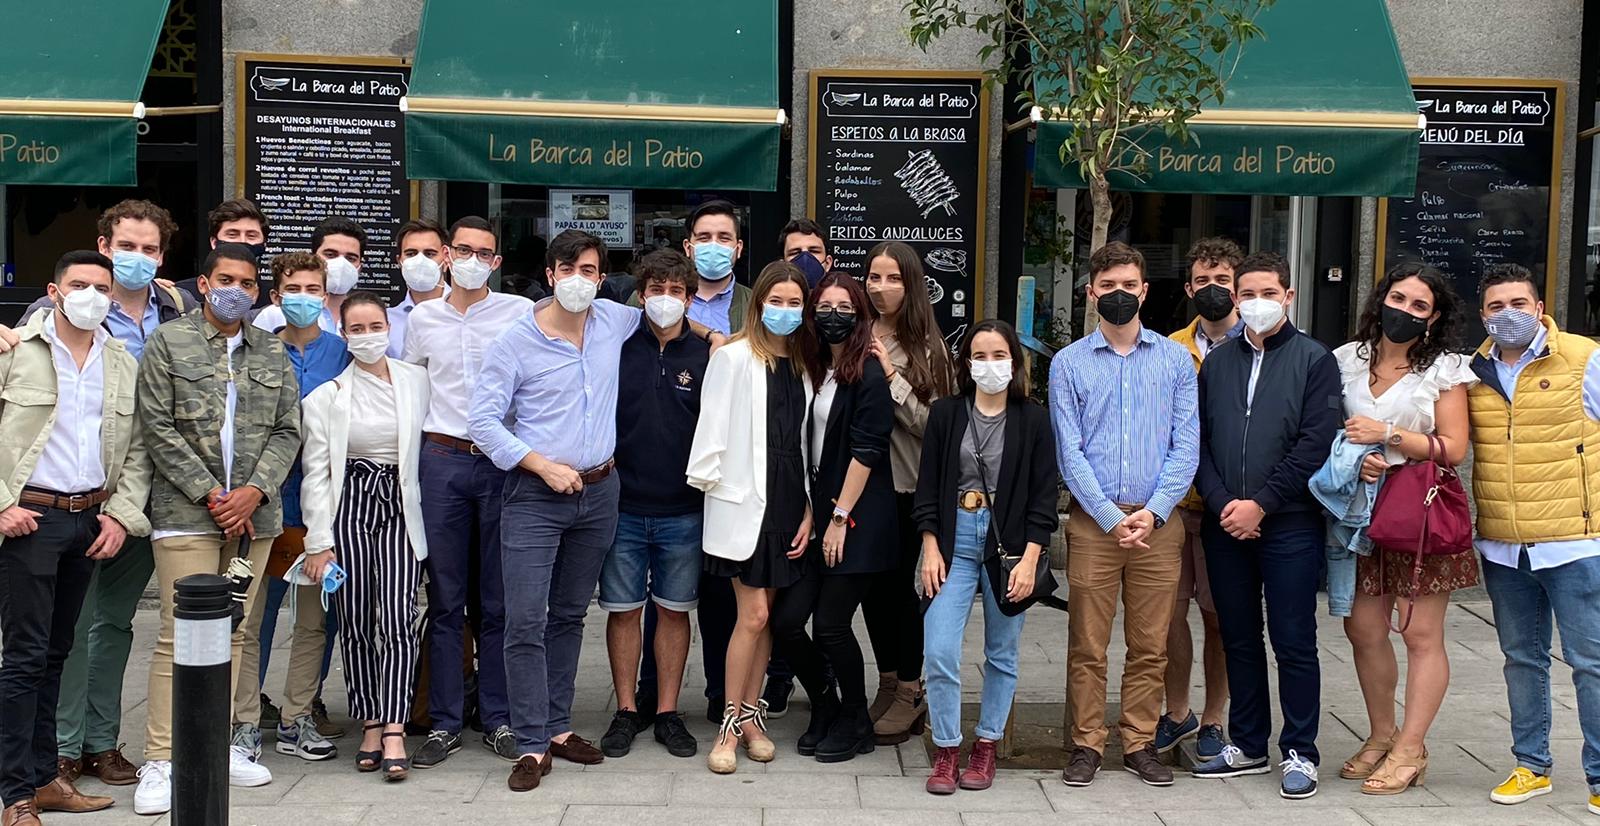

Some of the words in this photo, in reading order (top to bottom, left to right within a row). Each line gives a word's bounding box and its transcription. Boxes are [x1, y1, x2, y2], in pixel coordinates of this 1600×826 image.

[292, 78, 306, 92] La
[313, 80, 344, 94] Barca
[350, 81, 364, 94] del
[370, 80, 400, 96] Patio
[863, 92, 877, 106] La
[884, 94, 914, 107] Barca
[919, 94, 934, 108] del
[940, 93, 969, 108] Patio
[1435, 99, 1450, 112] La
[1456, 101, 1487, 114] Barca
[1492, 101, 1507, 114] del
[1512, 100, 1542, 115] Patio
[257, 115, 311, 124] DESAYUNOS
[313, 116, 396, 128] INTERNACIONALES
[282, 125, 332, 133] International
[334, 127, 372, 135] Breakfast
[832, 126, 884, 140] ESPETOS
[904, 128, 918, 140] LA
[924, 128, 966, 140] BRASA
[1464, 130, 1492, 142] DEL
[1498, 128, 1524, 143] DÍA
[0, 134, 59, 163] Patio
[489, 134, 515, 161] La
[530, 138, 592, 166] Barca
[604, 140, 631, 166] del
[646, 140, 702, 168] Patio
[836, 148, 874, 158] Sardinas
[835, 162, 871, 172] Calamar
[1160, 146, 1221, 173] Barca
[1234, 147, 1262, 174] del
[1276, 146, 1334, 174] Patio
[834, 189, 858, 200] Pulpo
[834, 202, 866, 212] Dorada
[830, 226, 876, 239] FRITOS
[882, 226, 963, 240] ANDALUCES
[834, 246, 866, 254] Rosada
